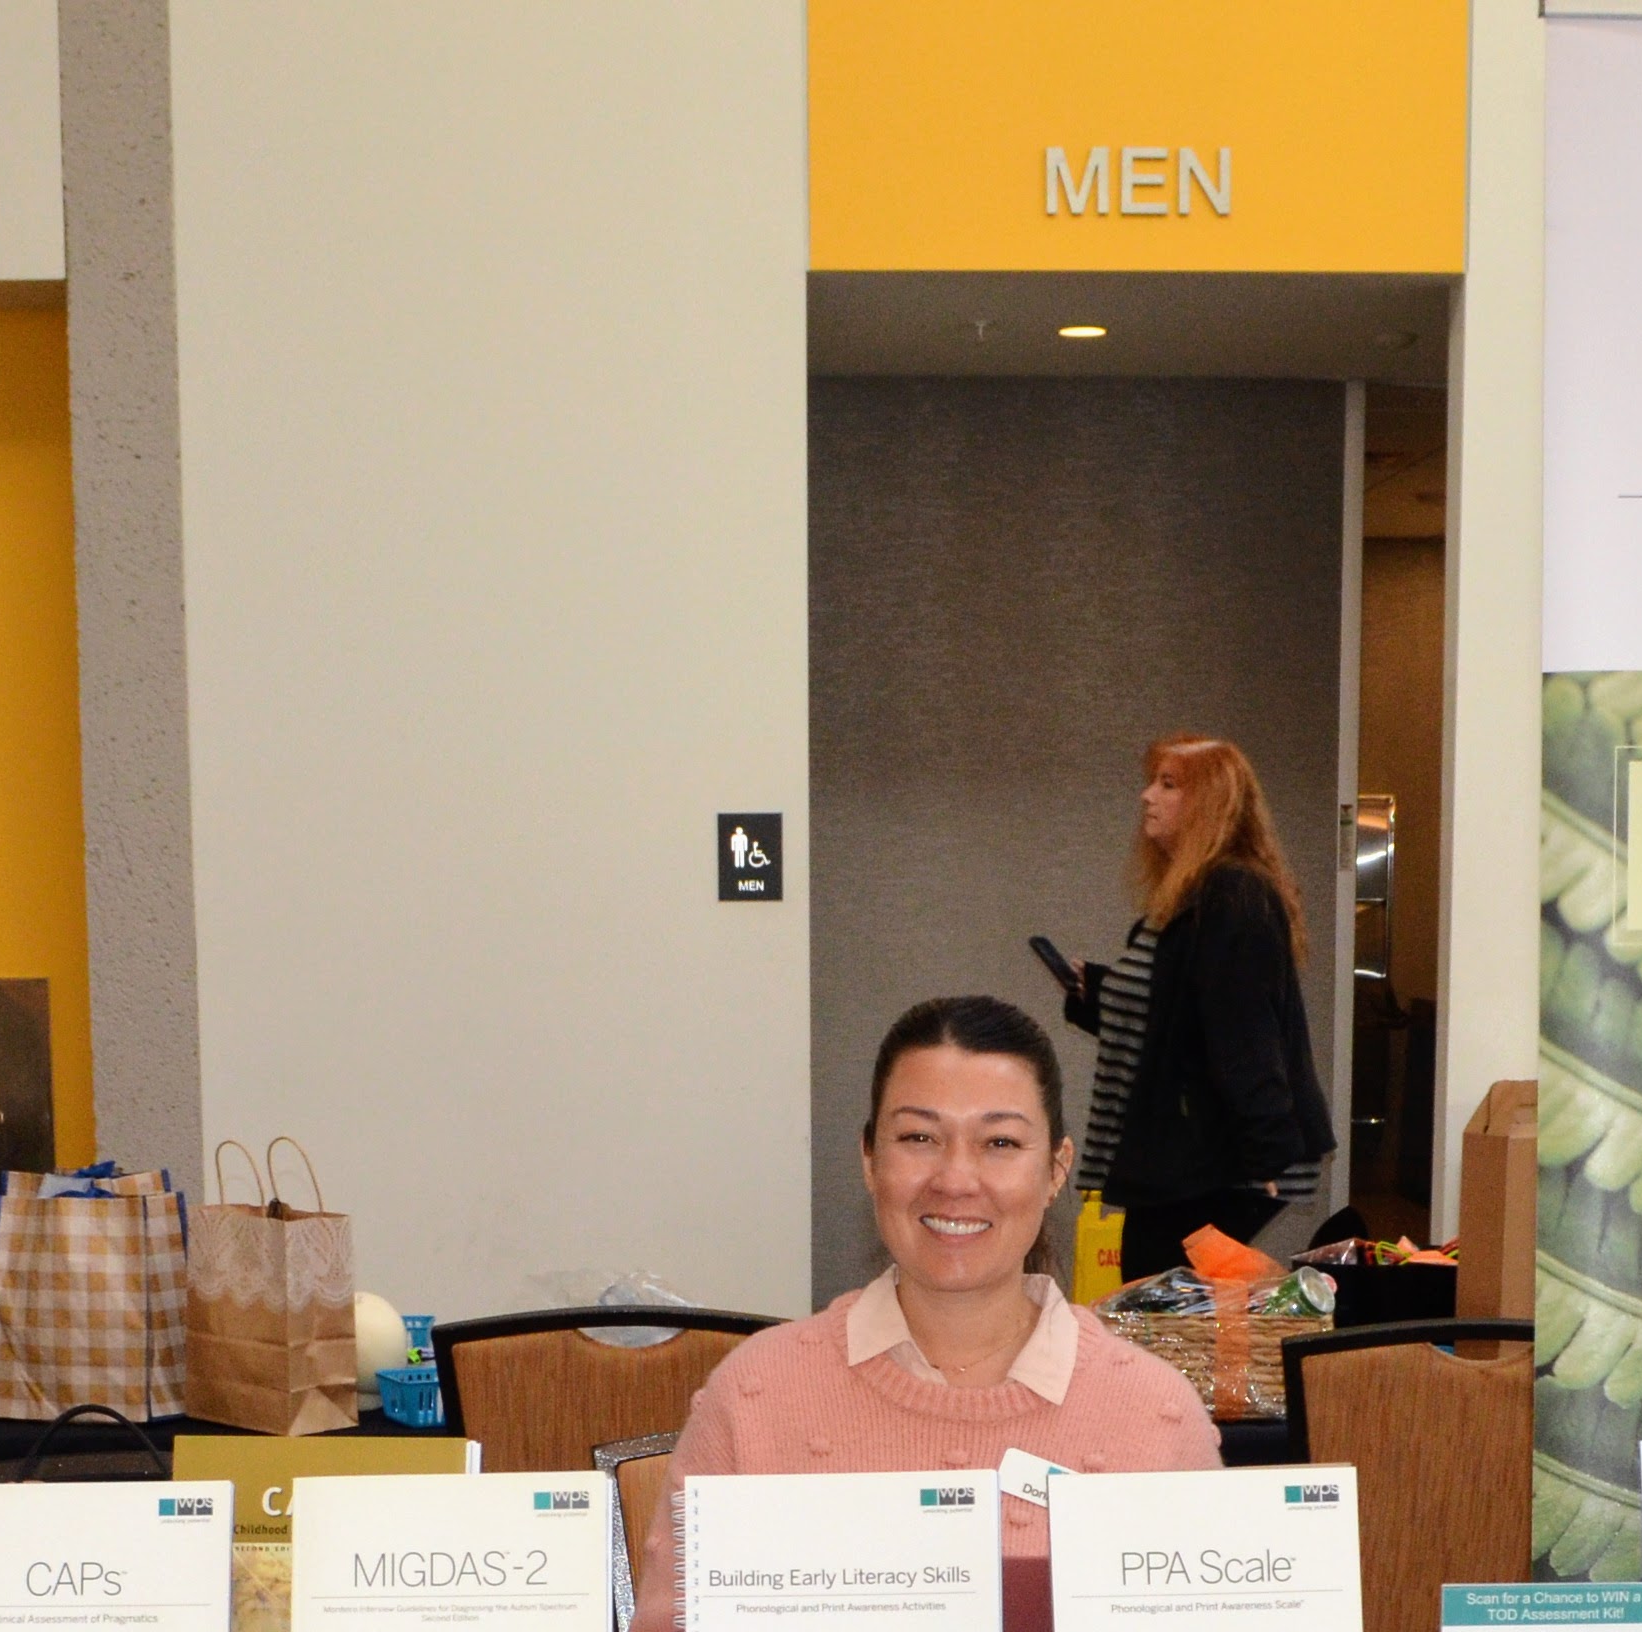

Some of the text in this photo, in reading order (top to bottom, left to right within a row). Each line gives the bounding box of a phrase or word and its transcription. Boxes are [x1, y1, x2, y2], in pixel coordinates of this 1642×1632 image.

[1044, 146, 1233, 216] MEN
[738, 880, 764, 892] MEN
[1121, 1551, 1191, 1586] PPA
[708, 1566, 971, 1590] Building Early Literacy Skills
[1466, 1591, 1642, 1606] Scan for a Chance to WIN a
[736, 1601, 946, 1616] Phonological and Print Awareness Activities
[1111, 1603, 1173, 1616] Phonological
[1174, 1603, 1194, 1613] and
[1195, 1602, 1219, 1612] Print
[1221, 1601, 1273, 1611] Awareness
[1487, 1607, 1625, 1621] TOD Assessment Kit!
[27, 1614, 88, 1624] Assessment
[90, 1613, 101, 1624] of
[102, 1613, 159, 1626] Pragmatics
